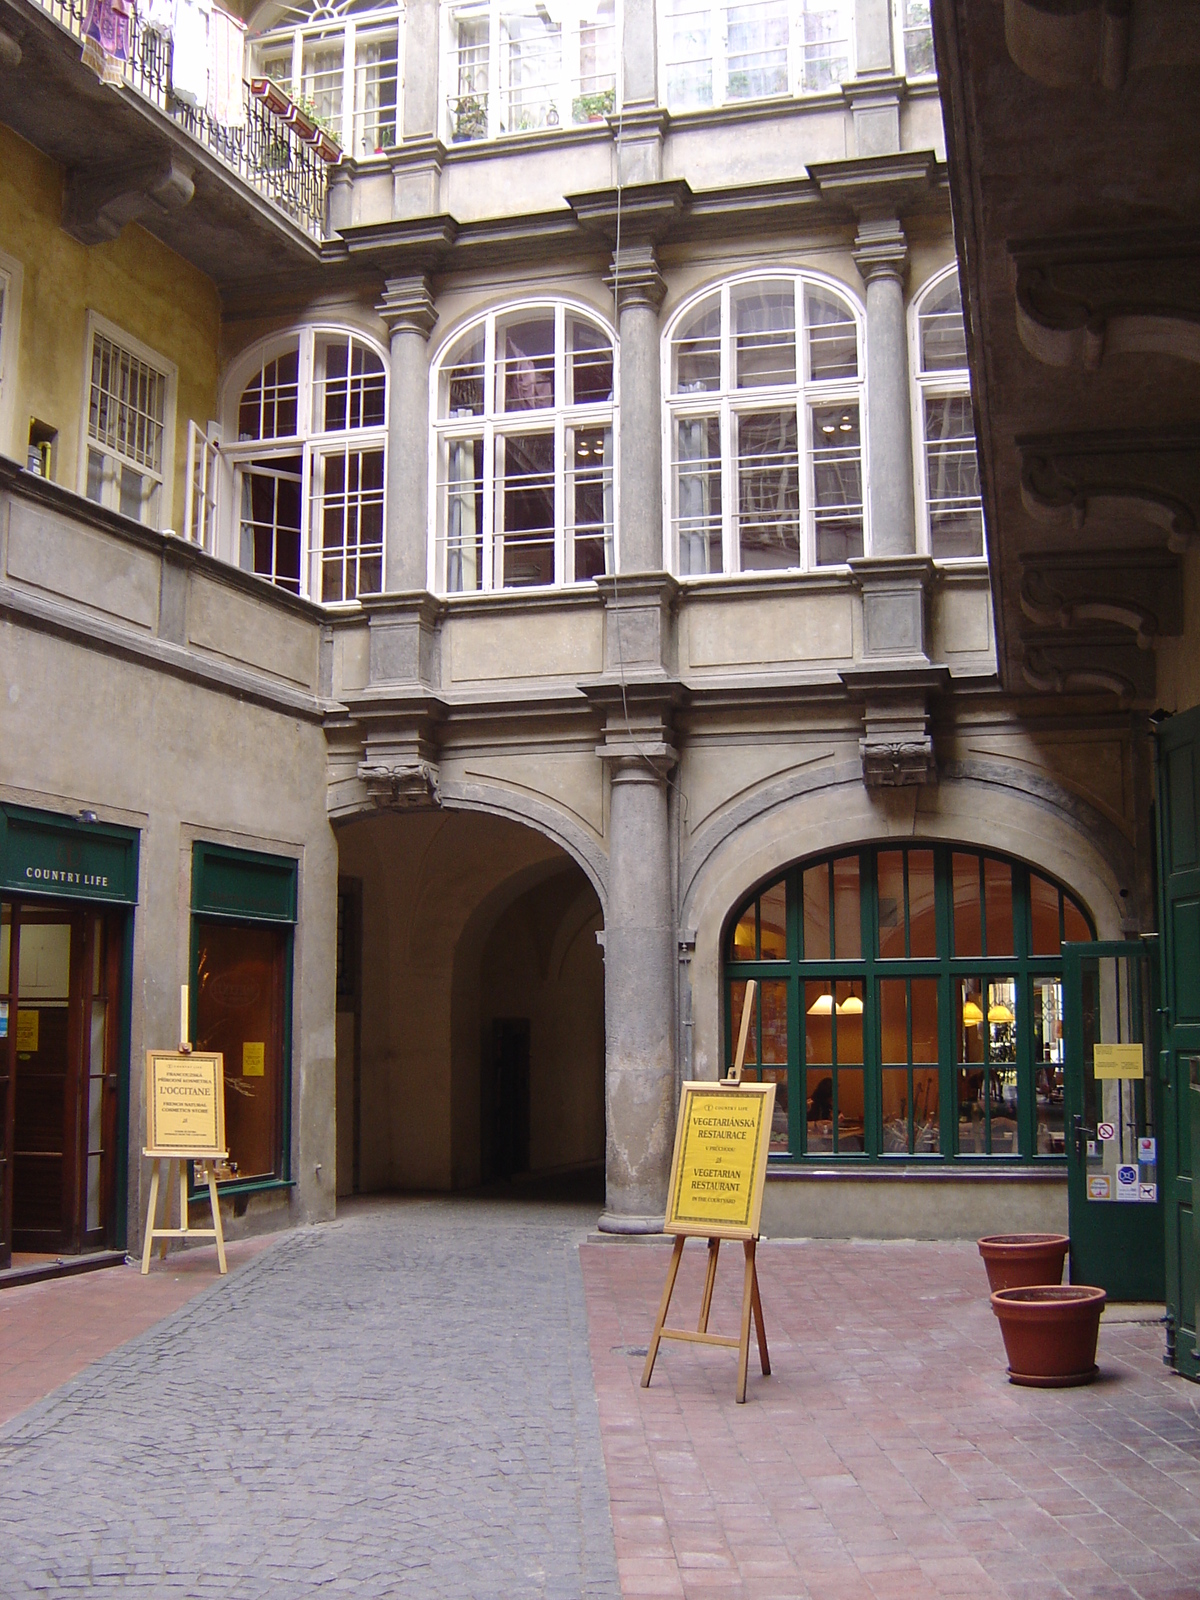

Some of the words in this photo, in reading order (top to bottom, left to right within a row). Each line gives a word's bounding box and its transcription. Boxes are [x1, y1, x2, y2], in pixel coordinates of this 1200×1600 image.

[26, 867, 80, 883] COUNTRY
[84, 874, 108, 886] LIFE
[160, 1086, 210, 1095] L'OCCITANE
[693, 1116, 755, 1127] VEGETARIÁNSKÁ
[697, 1129, 747, 1139] RESTAURACE
[693, 1168, 741, 1178] VEGETARIAN
[691, 1180, 740, 1191] RESTAURANT
